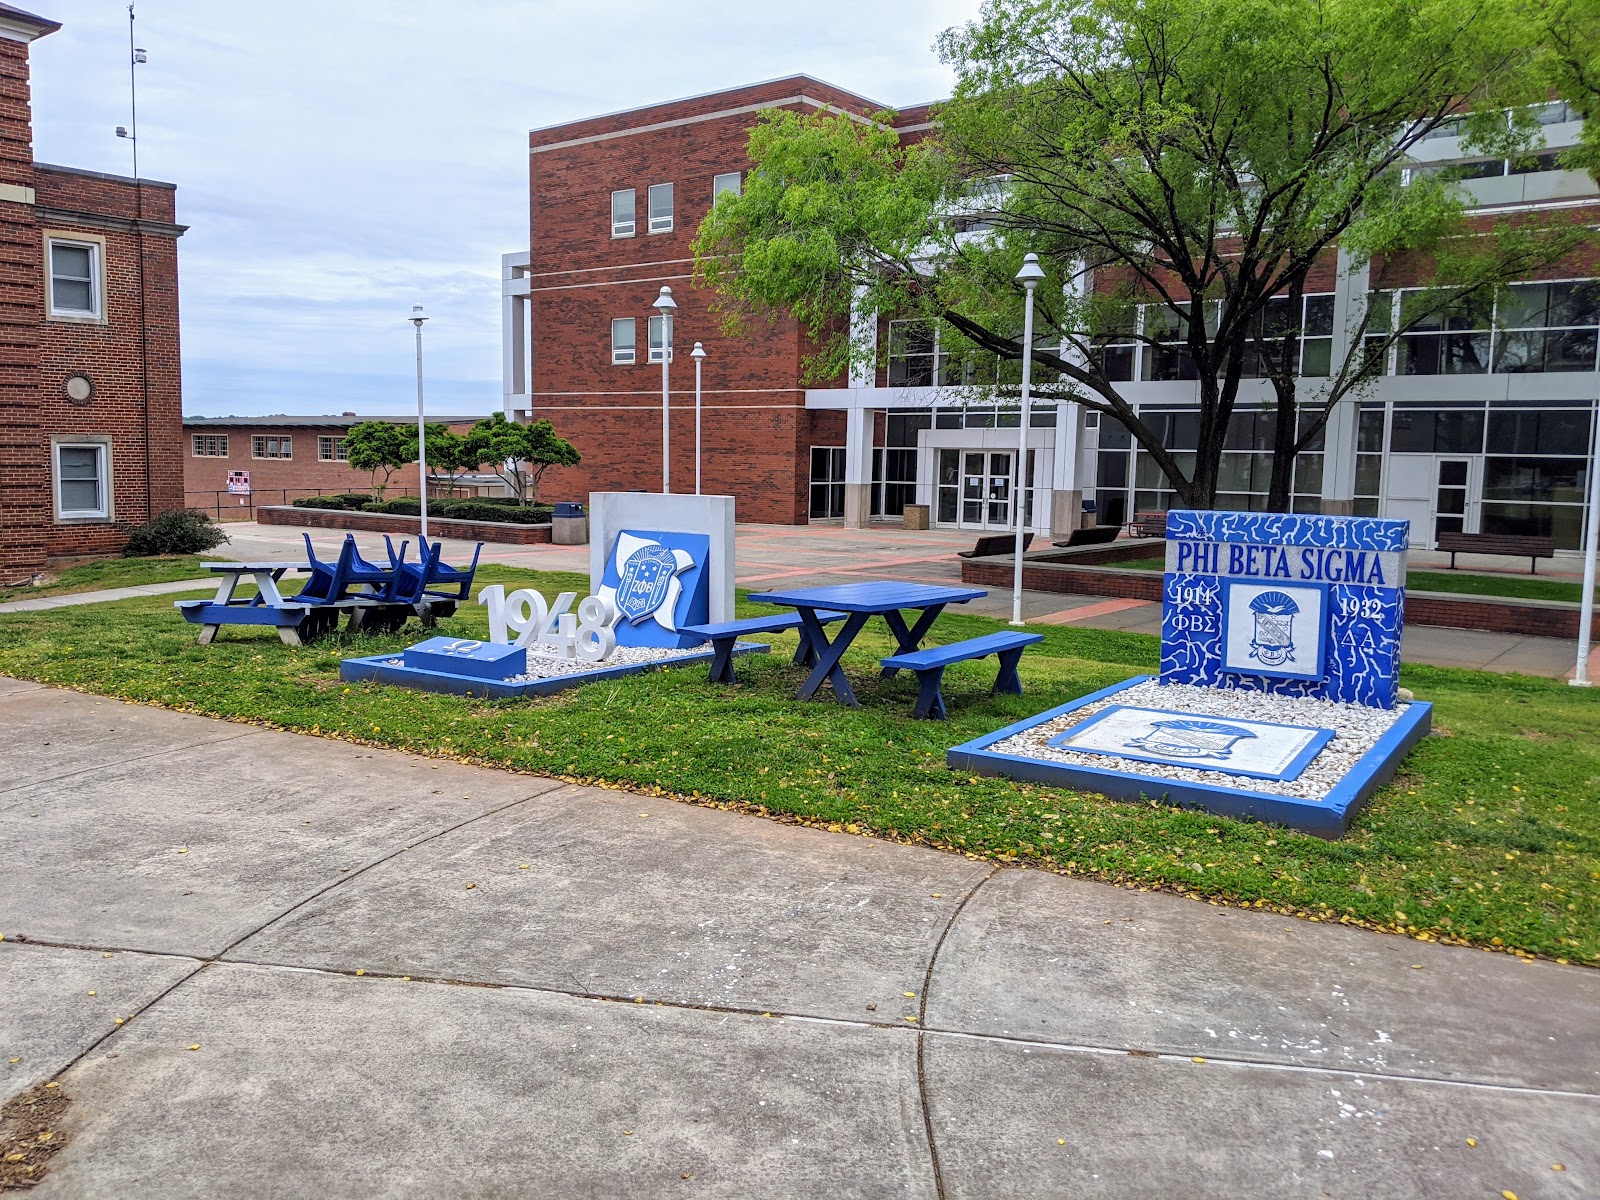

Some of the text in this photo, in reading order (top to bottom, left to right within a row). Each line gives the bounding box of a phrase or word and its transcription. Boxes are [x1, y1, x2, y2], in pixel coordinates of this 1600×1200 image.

[1177, 542, 1386, 585] PHI BETA SIGMA
[1175, 586, 1212, 605] 1914
[1340, 598, 1382, 619] 1932
[478, 584, 616, 662] 1948
